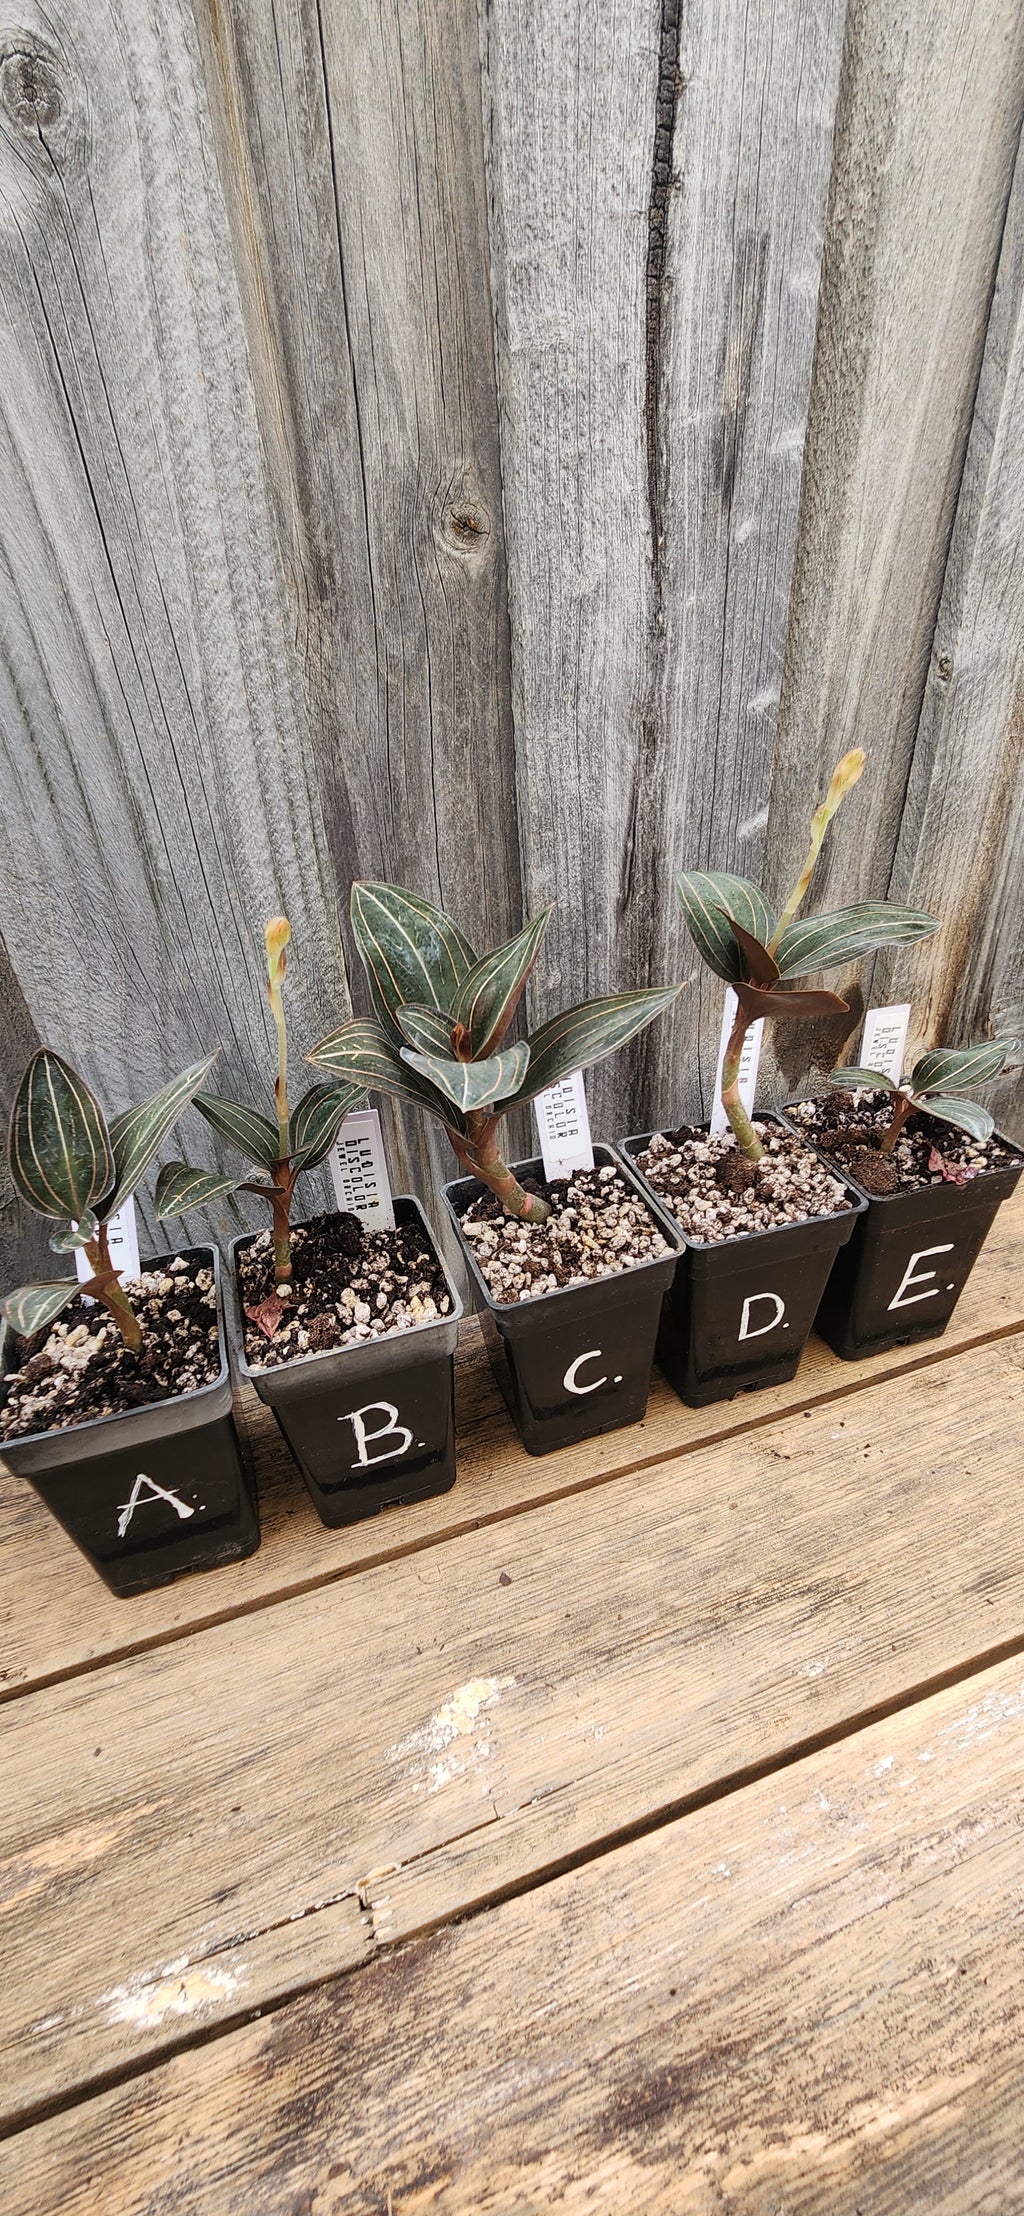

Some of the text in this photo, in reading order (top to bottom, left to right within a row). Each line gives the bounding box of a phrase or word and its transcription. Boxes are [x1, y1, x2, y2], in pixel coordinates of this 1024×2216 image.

[873, 1027, 891, 1068] DISCO
[882, 1026, 901, 1074] LUDIS
[550, 1083, 568, 1138] SCOLOR
[562, 1077, 579, 1136] DISIA
[336, 1141, 355, 1212] JEWEL ORCHID
[345, 1140, 368, 1210] DISCOLOR
[357, 1137, 379, 1209] LUDISIA
[887, 1243, 955, 1311] E.
[738, 1292, 789, 1341] D.
[563, 1350, 623, 1395] C.
[337, 1401, 426, 1468] B.
